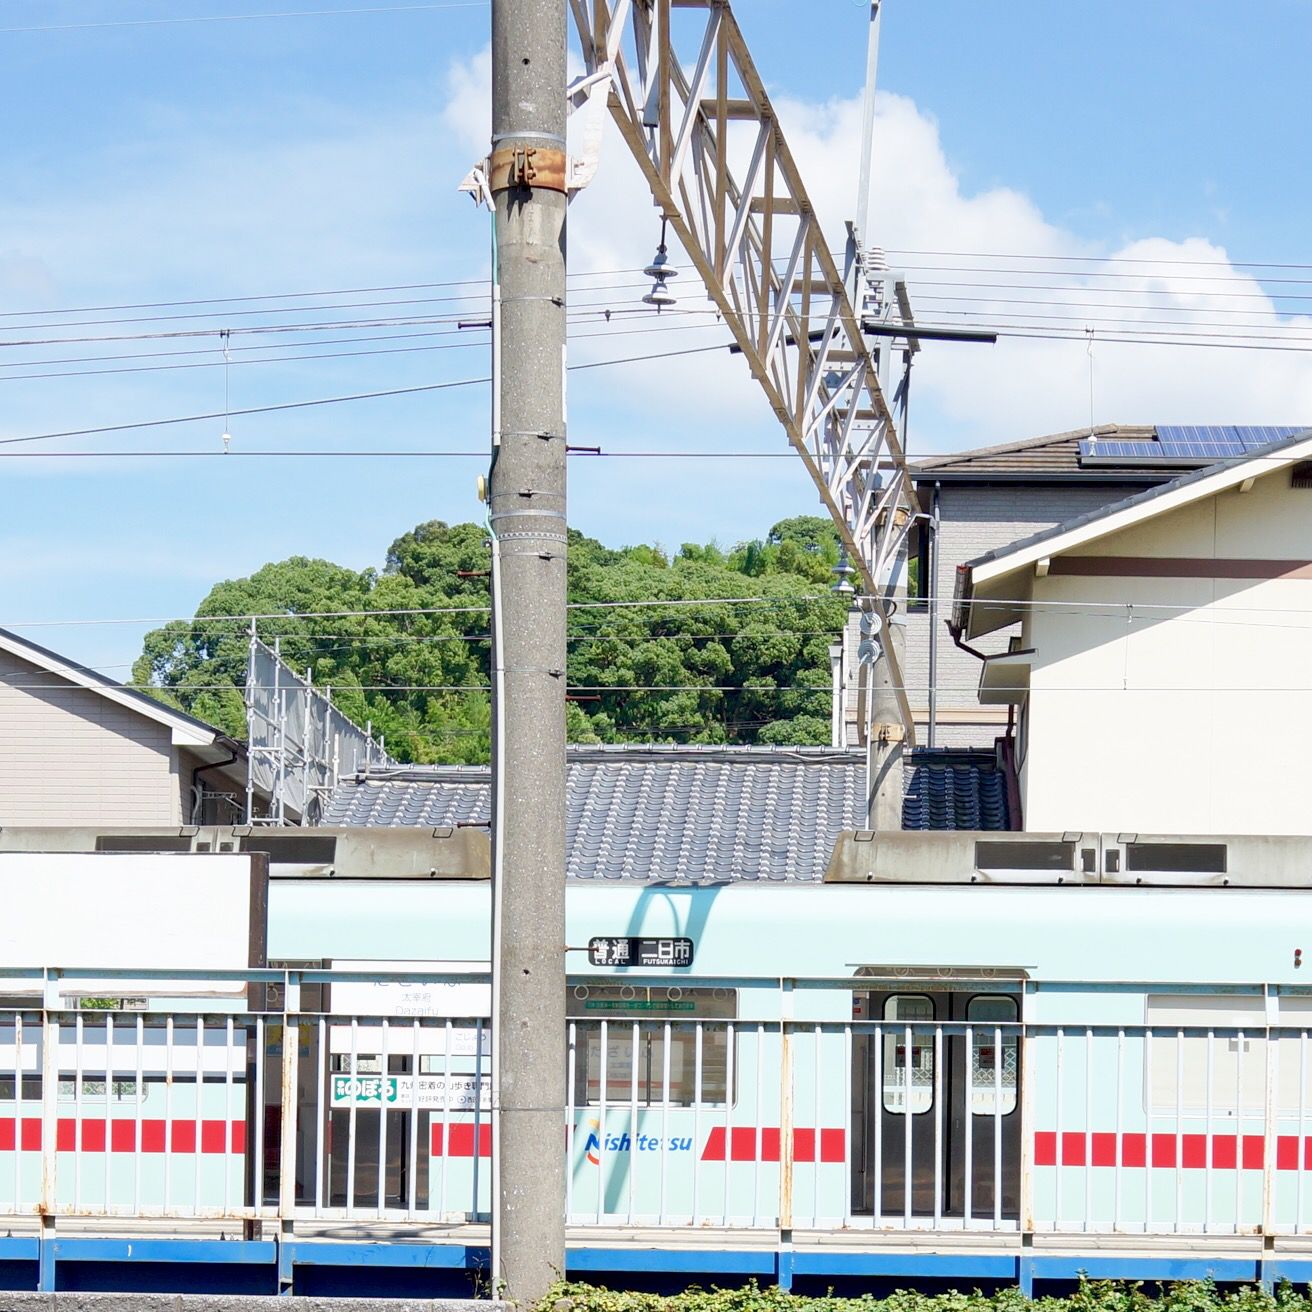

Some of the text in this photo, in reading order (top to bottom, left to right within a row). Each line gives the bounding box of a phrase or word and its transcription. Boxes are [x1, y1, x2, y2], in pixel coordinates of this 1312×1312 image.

[592, 939, 691, 960] 普通 二日市
[584, 1133, 693, 1151] Nishtesu
